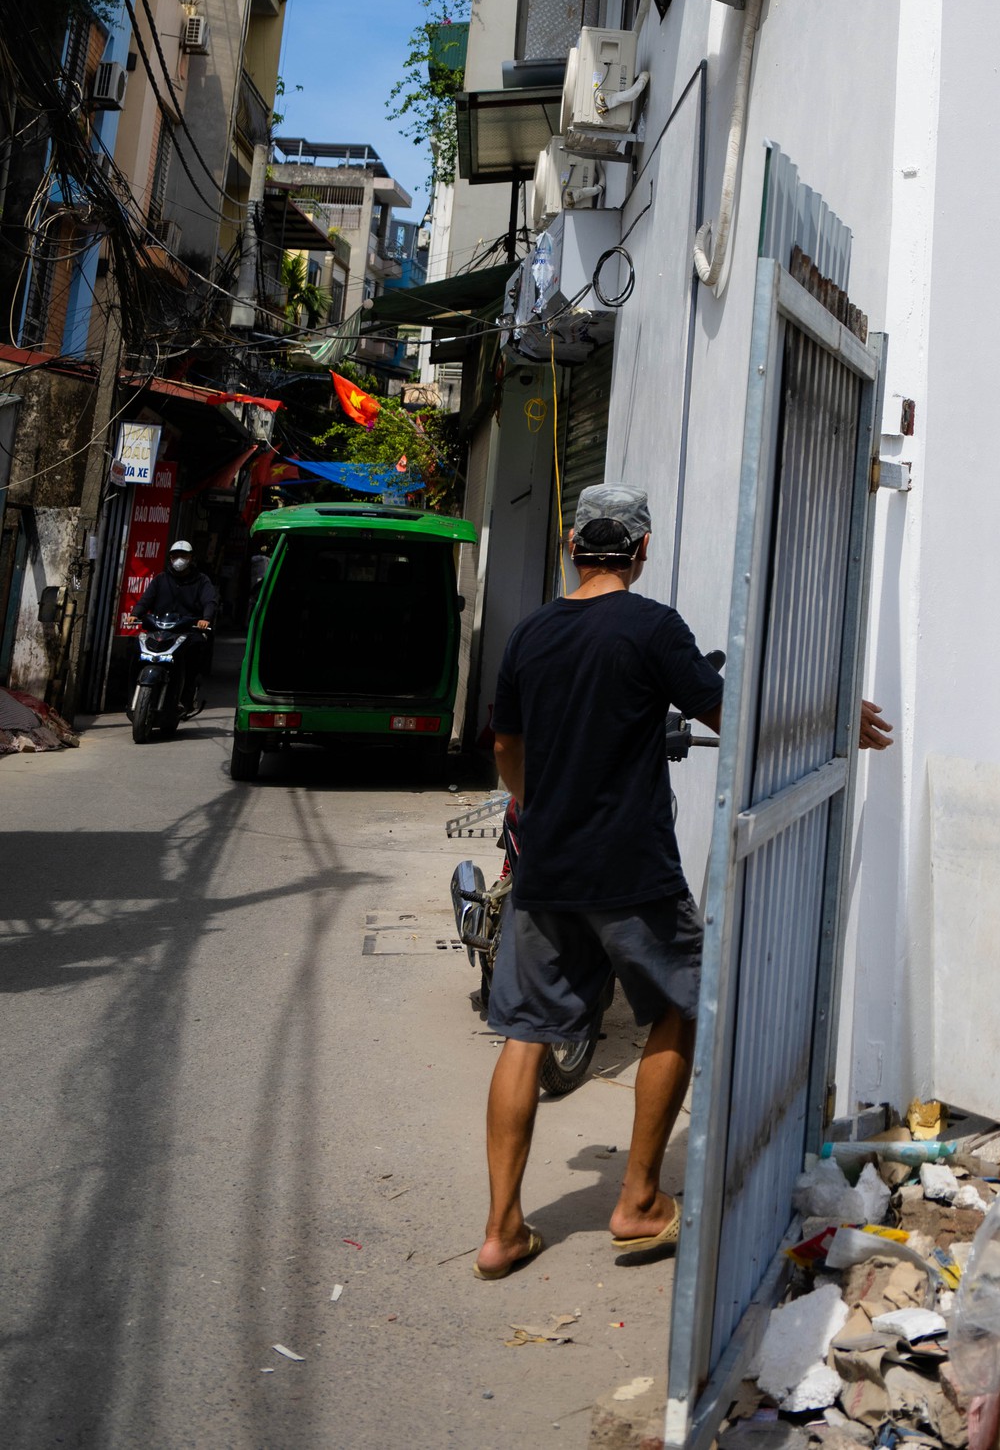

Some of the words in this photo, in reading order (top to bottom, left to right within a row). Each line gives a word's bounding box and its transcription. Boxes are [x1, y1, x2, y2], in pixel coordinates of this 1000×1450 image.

[137, 467, 149, 478] XE
[134, 541, 145, 558] XE
[126, 576, 144, 594] THAY
